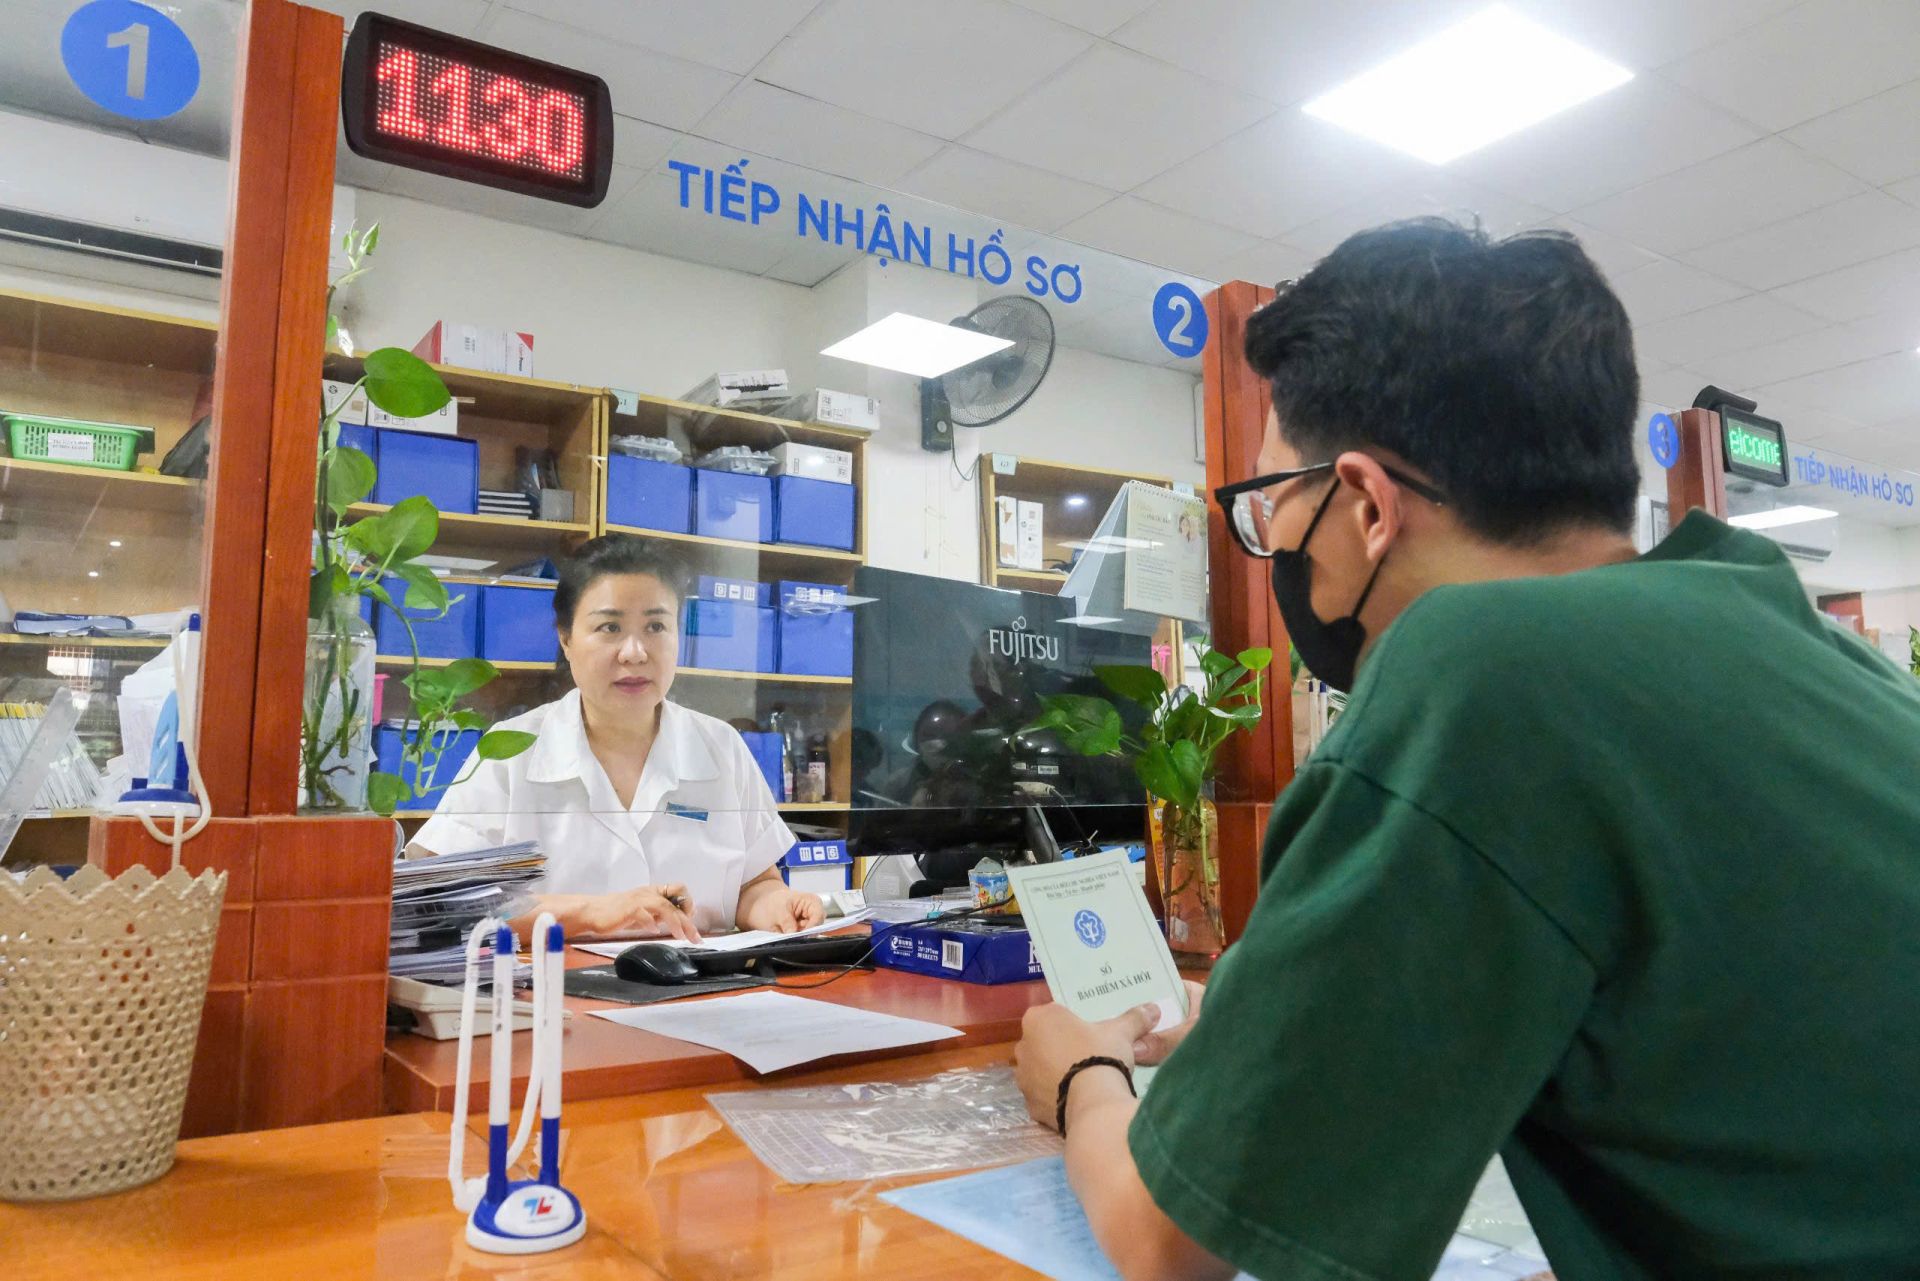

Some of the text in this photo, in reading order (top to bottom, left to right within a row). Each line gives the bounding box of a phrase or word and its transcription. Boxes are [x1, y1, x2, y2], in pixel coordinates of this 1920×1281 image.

[106, 22, 150, 100] 1
[376, 49, 583, 171] 1130
[668, 158, 1083, 304] TIẾP NHẬN HỒ SƠ
[1167, 295, 1194, 348] 2
[1656, 421, 1672, 460] 3
[1794, 451, 1826, 485] TIẾP
[1829, 465, 1869, 498] NHẬN
[1895, 481, 1914, 507] SƠ
[988, 628, 1059, 666] FUJITSU
